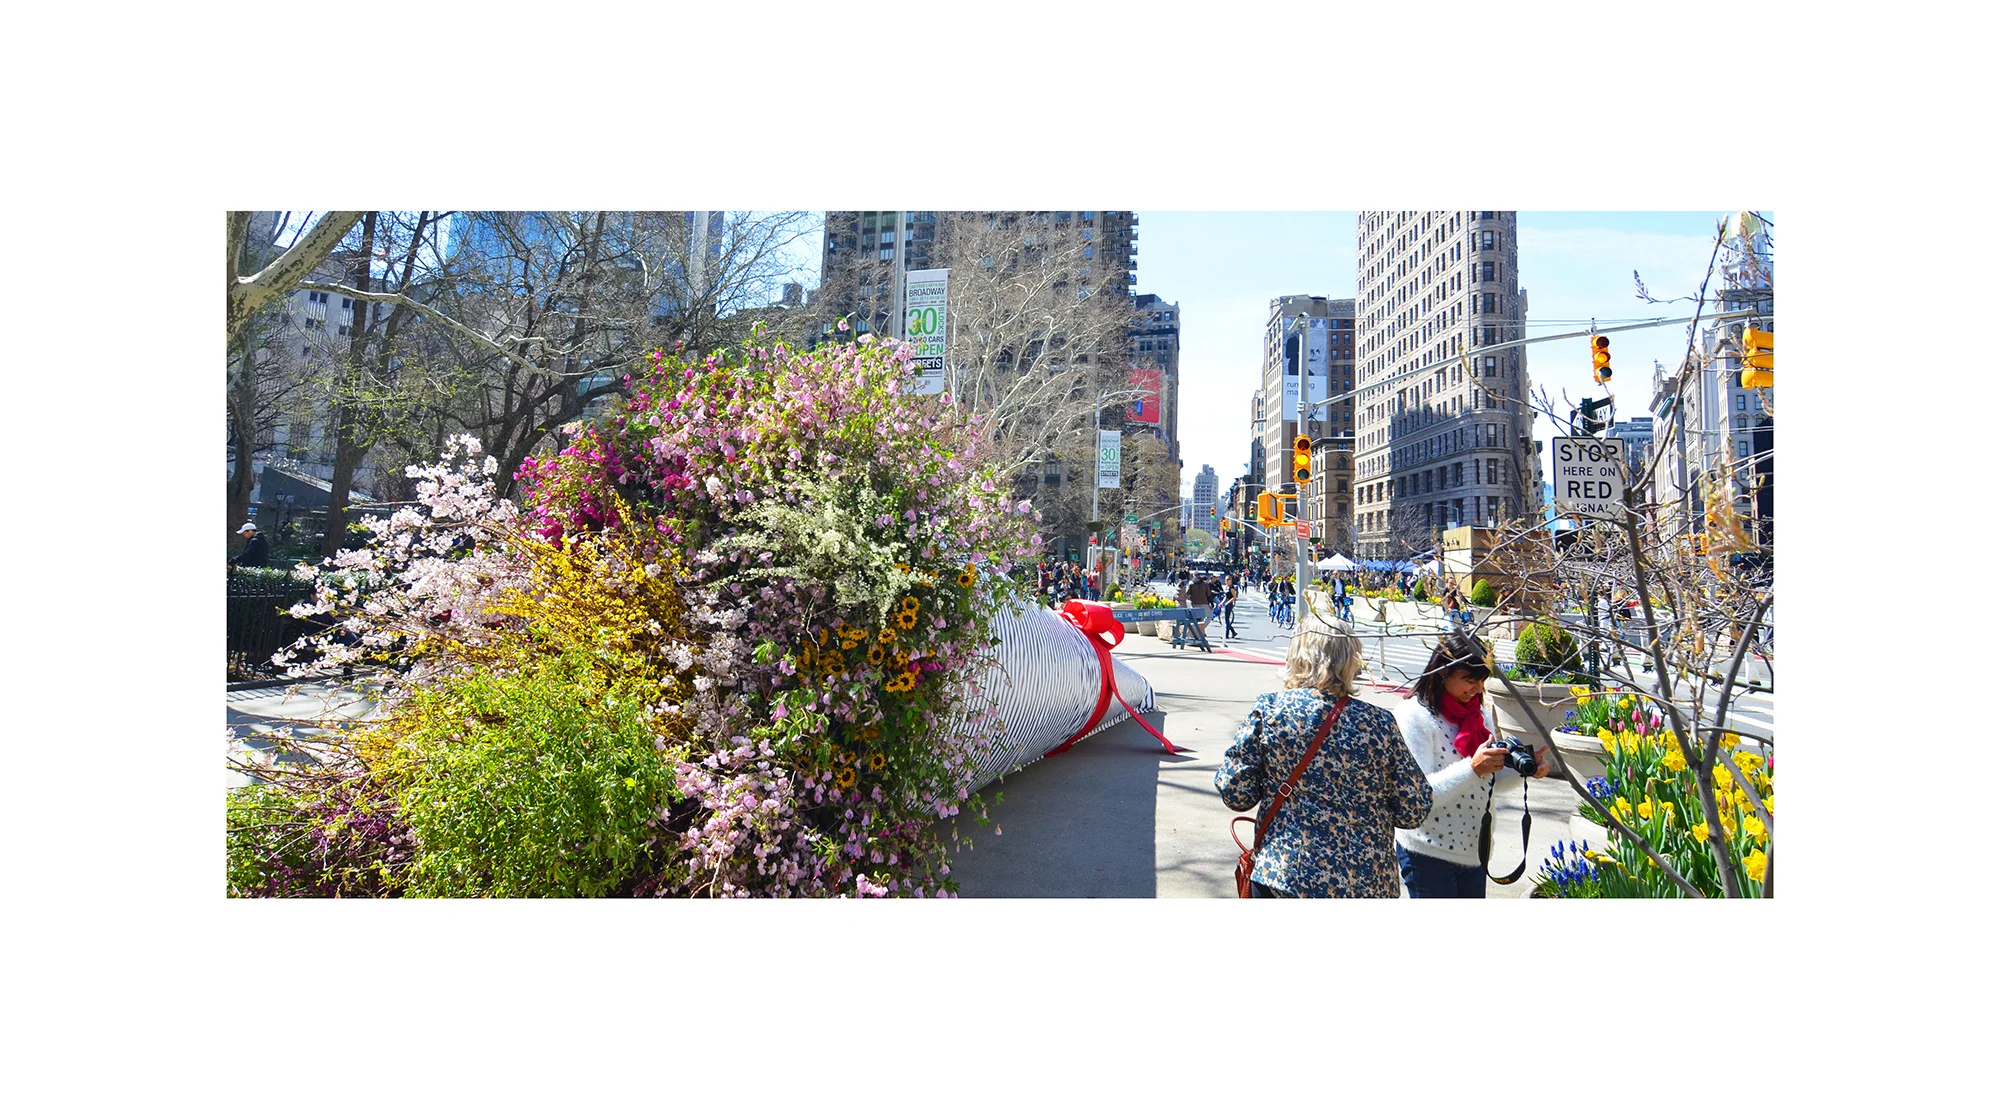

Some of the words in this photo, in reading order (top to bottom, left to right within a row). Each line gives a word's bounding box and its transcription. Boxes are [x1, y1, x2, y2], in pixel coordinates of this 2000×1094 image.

[908, 287, 945, 297] BROADWAY
[908, 307, 938, 336] 30
[915, 343, 944, 356] OPEN
[907, 358, 942, 368] TREETS
[1101, 447, 1116, 461] 30
[1560, 444, 1618, 462] STOP
[1563, 466, 1593, 476] HERE
[1600, 466, 1616, 477] ON
[1567, 480, 1612, 499] RED
[1573, 502, 1610, 513] IGNA
